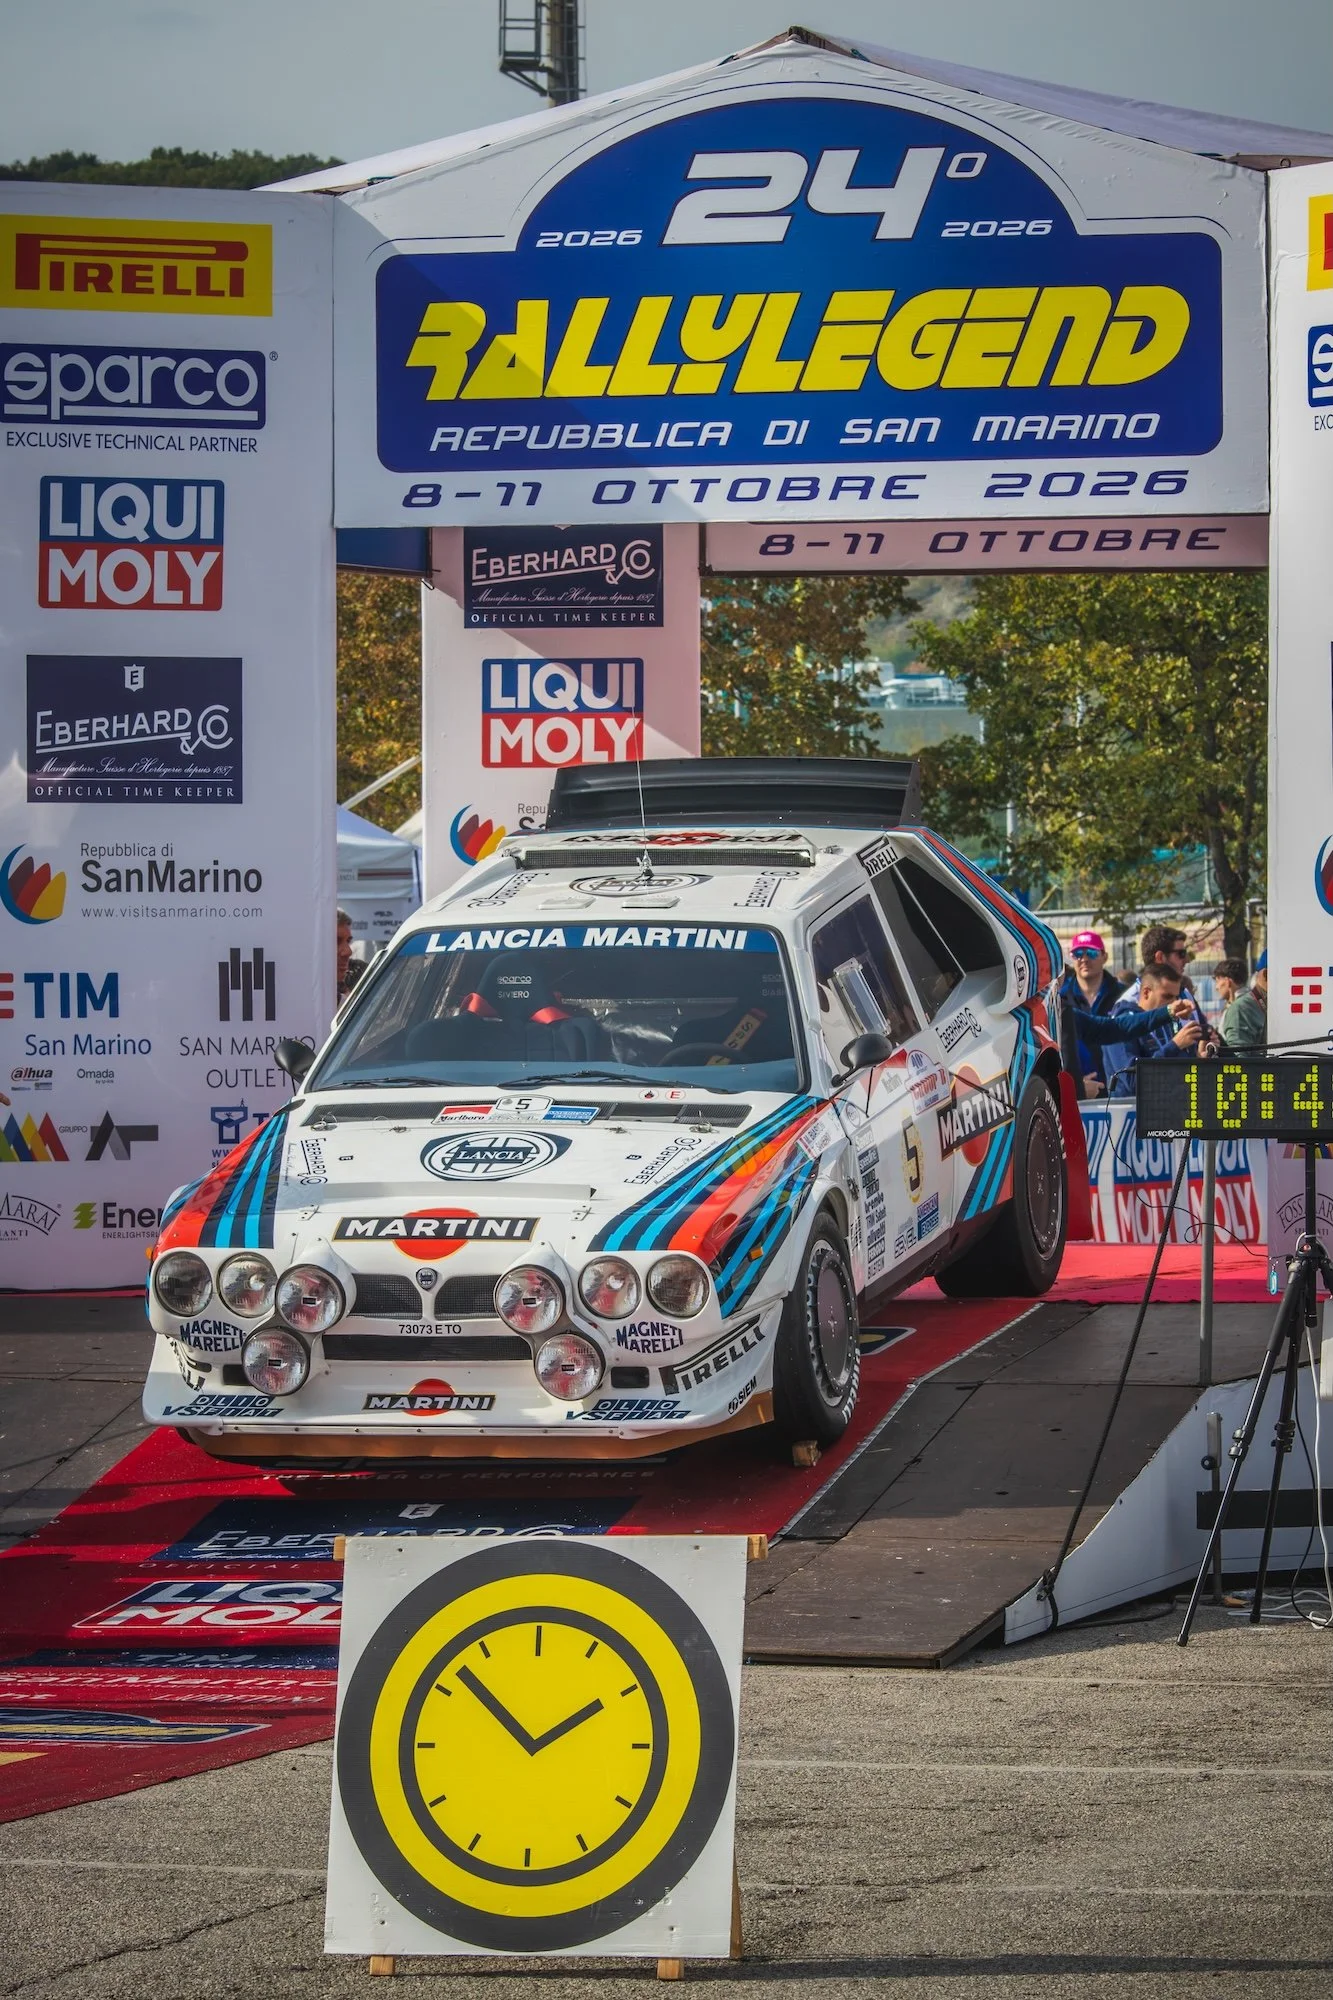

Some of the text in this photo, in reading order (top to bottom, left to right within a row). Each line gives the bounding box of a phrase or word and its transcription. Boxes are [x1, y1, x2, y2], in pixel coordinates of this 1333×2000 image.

[535, 228, 643, 250] 2026
[940, 218, 1054, 239] 2026
[15, 233, 249, 297] PIRELLI
[405, 285, 1191, 401] RALLYLEGEND
[4, 352, 258, 420] sparco
[6, 431, 258, 452] EXCLUSIVE TECHNICAL PARTNER
[429, 412, 1162, 453] REPUBBLICA DI SAN MARINO
[592, 474, 928, 505] OTTOBRE
[983, 469, 1191, 500] 2026
[50, 483, 215, 542] LIQUI
[929, 526, 1229, 553] OTTOBRE
[48, 548, 221, 605] MOLY
[472, 588, 527, 606] Manufacture
[528, 587, 556, 602] Suisse
[609, 592, 635, 605] depuis
[471, 612, 656, 622] OFFICIAL TIME KEEPER
[490, 662, 636, 712] LIQUI
[490, 717, 641, 764] MOLY
[36, 757, 234, 777] Manufacture Suisse d'Horlogerie depuis 1887
[35, 787, 235, 797] OFFICIAL TIME KEEPER
[80, 843, 174, 859] Repubblica di
[856, 835, 898, 877] PIRELLI
[81, 906, 263, 918] www.visitsanmarino.com
[425, 927, 748, 953] LANCIA MARTINI
[24, 972, 119, 1018] TIM
[25, 1034, 151, 1056] San Marino
[180, 1037, 221, 1056] SAN
[77, 1068, 115, 1079] Omada
[206, 1069, 287, 1088] OUTLET
[515, 1098, 532, 1110] 5
[670, 1090, 681, 1099] E
[439, 1115, 485, 1123] Marlboro
[940, 1081, 1010, 1149] MARTINI
[457, 1151, 525, 1160] LANCIA
[624, 1145, 679, 1185] EBERHARD
[902, 1117, 920, 1192] 5
[344, 1219, 527, 1238] MARTINI
[180, 1319, 243, 1343] MAGNETI
[398, 1324, 433, 1335] 73073
[616, 1321, 683, 1344] MAGNETI
[624, 1338, 684, 1353] MARELLI
[659, 1314, 766, 1396] PIRELLI
[194, 1395, 271, 1407] OLIO
[739, 1376, 758, 1405] SIEM
[369, 1396, 491, 1410] MARTINI
[598, 1401, 675, 1410] OLIO
[142, 1582, 342, 1604] LIQ
[98, 1606, 342, 1625] MOL
[134, 1654, 256, 1663] TIM
